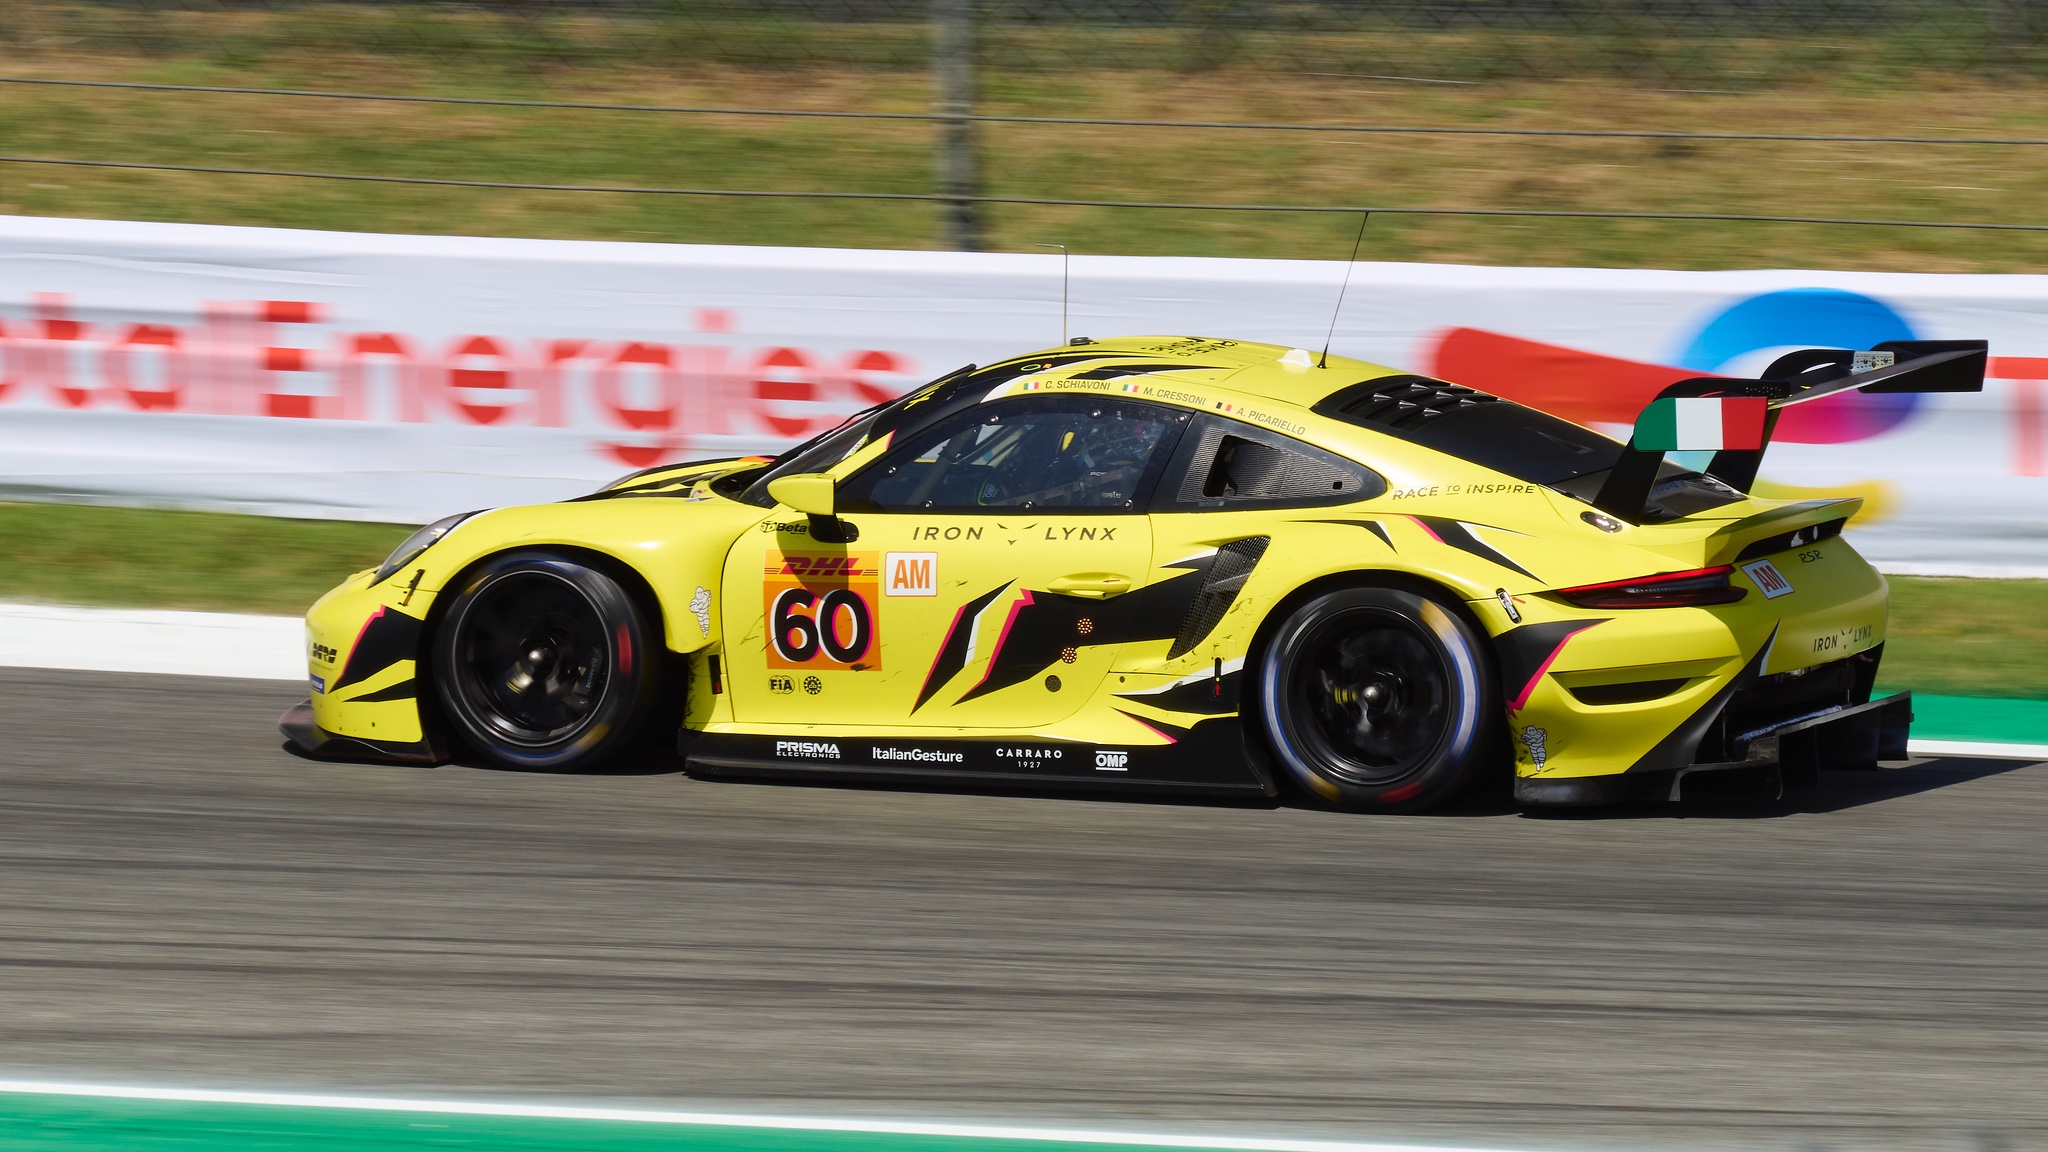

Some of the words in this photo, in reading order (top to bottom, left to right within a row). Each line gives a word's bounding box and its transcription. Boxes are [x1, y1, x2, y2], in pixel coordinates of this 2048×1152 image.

[1045, 380, 1054, 389] C.
[1057, 380, 1111, 391] SCHIAVONI
[1143, 387, 1155, 397] M.
[1157, 388, 1207, 406] CRESSONI
[1236, 407, 1246, 417] A.
[1247, 410, 1306, 435] PICARIELLO
[1392, 486, 1439, 501] RACE
[776, 522, 808, 533] Beta
[912, 526, 984, 541] IRON
[1044, 526, 1118, 541] LYNX
[1798, 550, 1823, 564] RSR
[779, 557, 864, 576] DHL
[892, 559, 931, 589] AM
[1752, 564, 1786, 593] AM
[770, 588, 873, 663] 60
[1813, 634, 1838, 653] IRON
[1853, 624, 1873, 643] LYNX
[776, 741, 841, 754] PRISMA
[872, 746, 964, 763] ItalianGesture
[995, 748, 1063, 759] CARRARO
[1095, 754, 1128, 768] OMP
